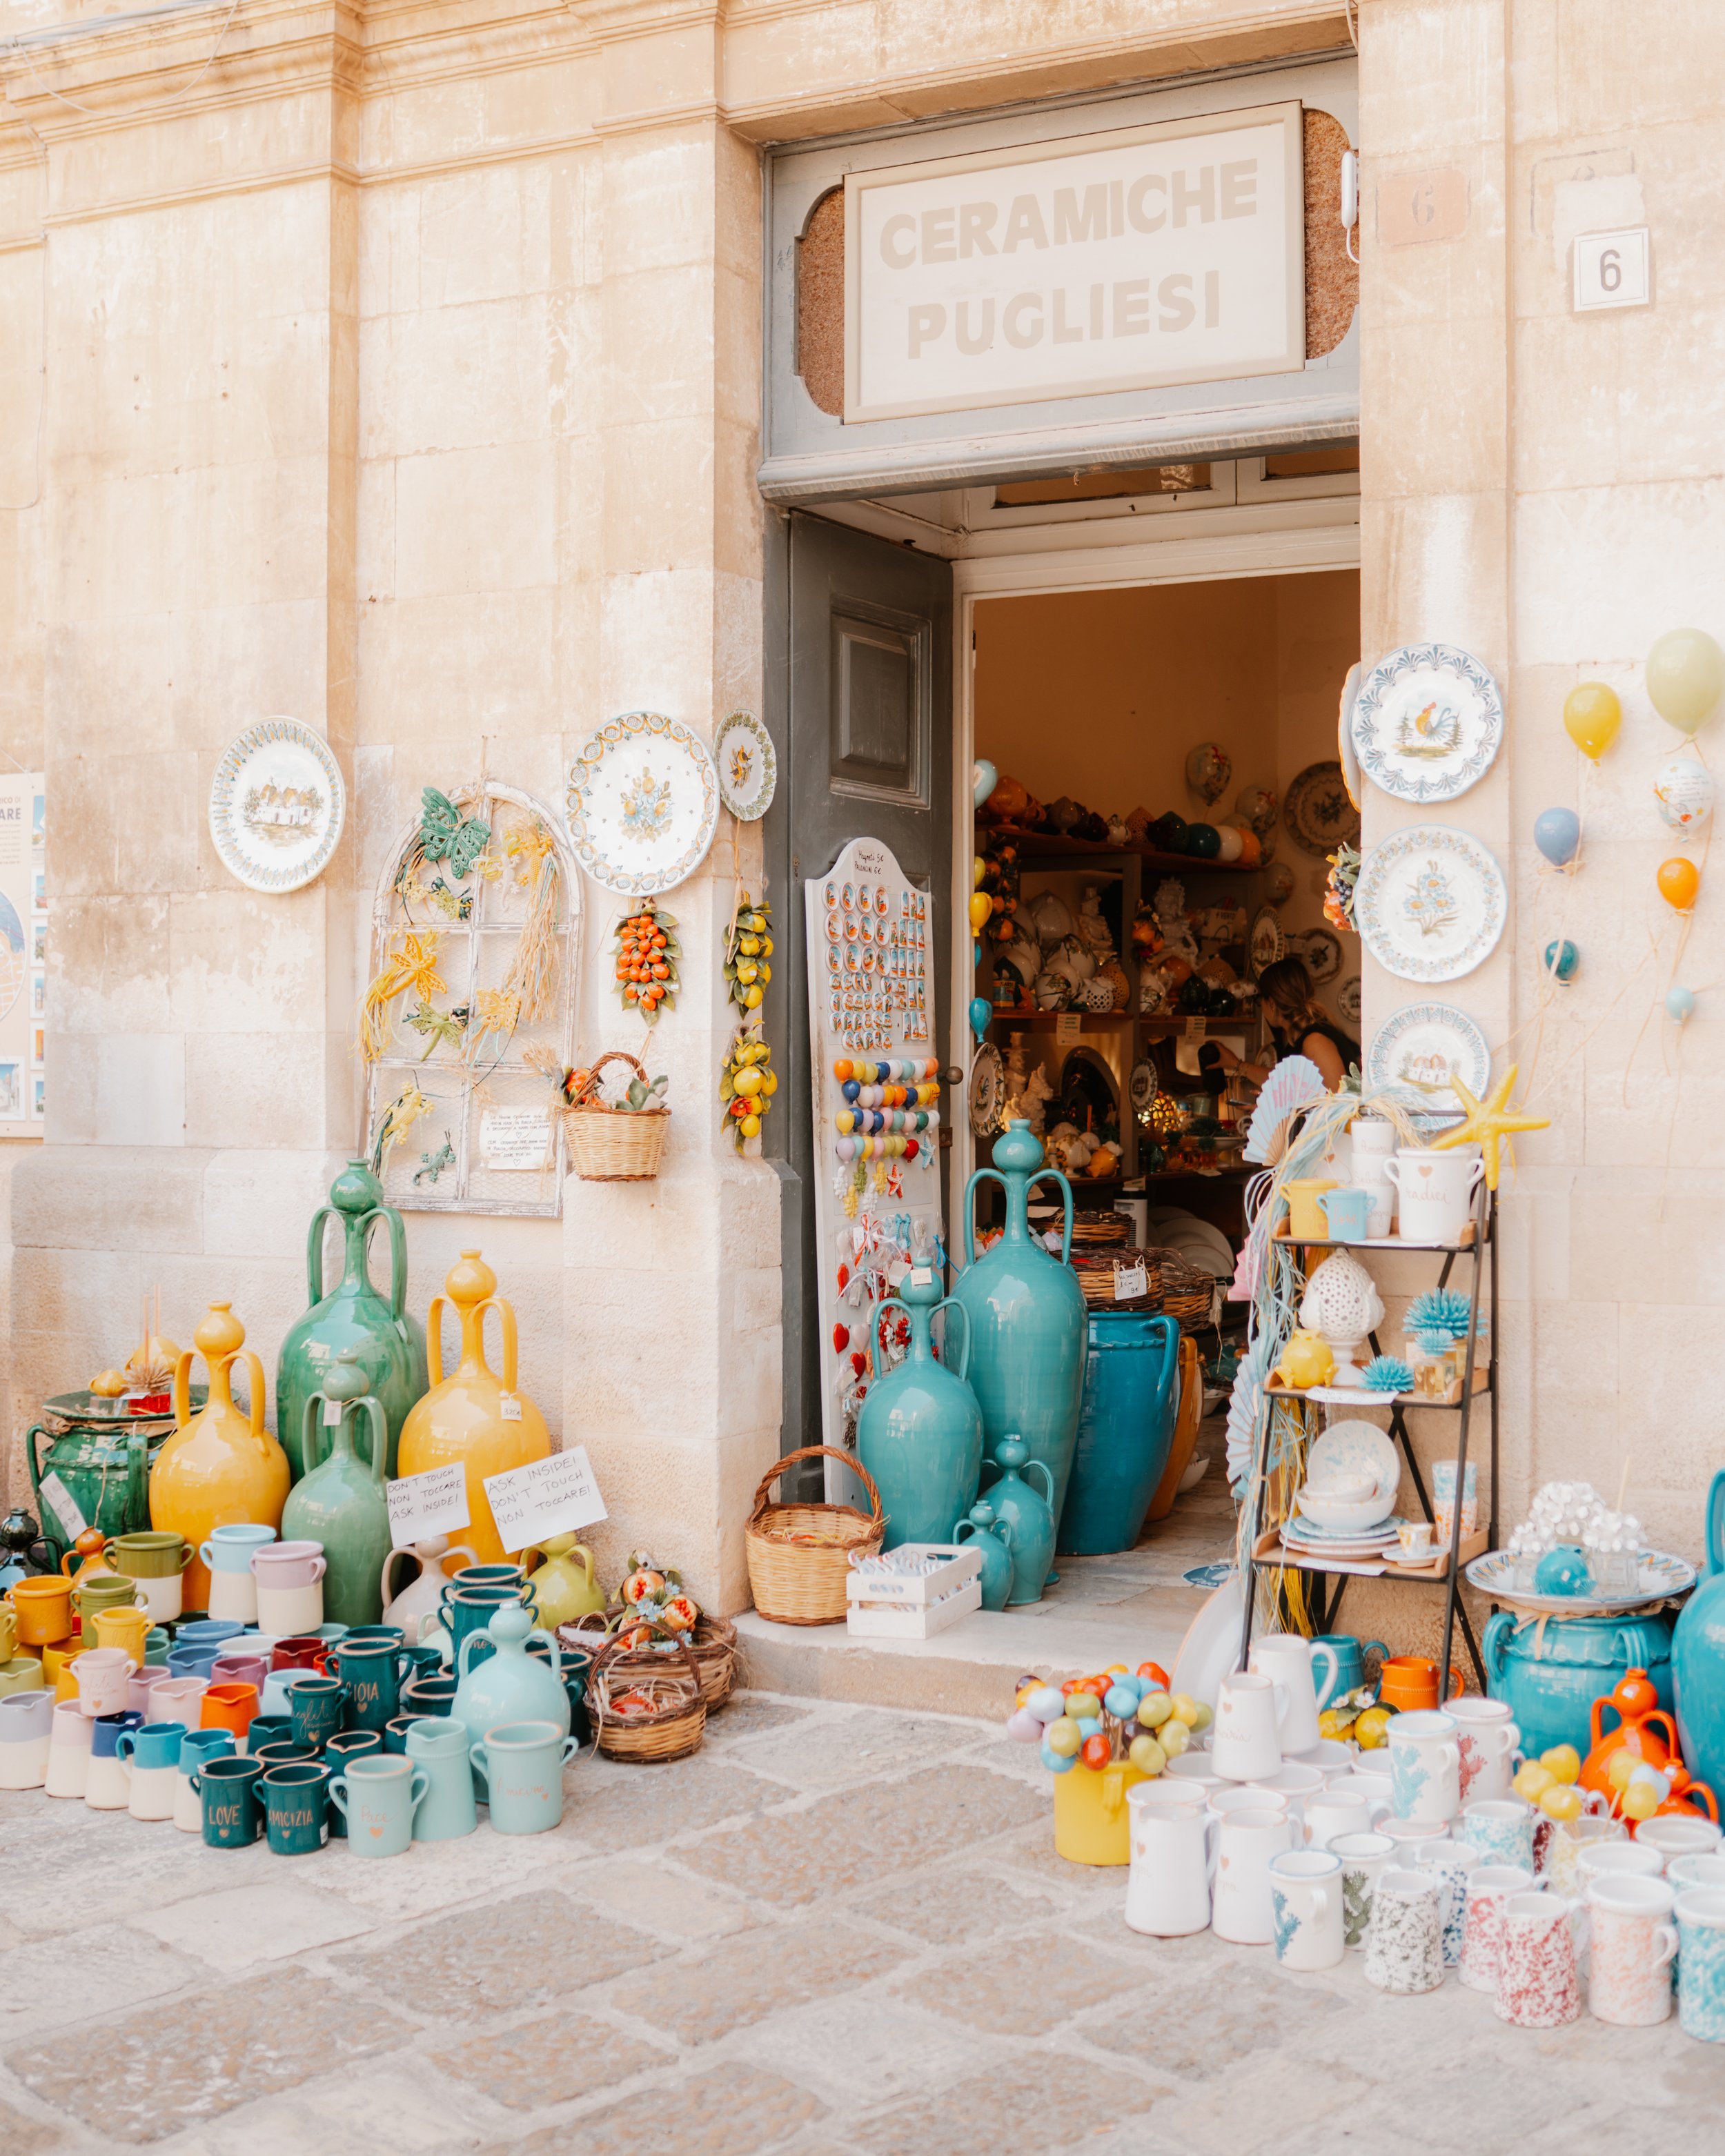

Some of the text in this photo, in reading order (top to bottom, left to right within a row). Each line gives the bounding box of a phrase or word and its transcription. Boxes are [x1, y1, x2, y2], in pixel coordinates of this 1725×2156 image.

[880, 159, 1258, 269] CERAMICHE
[1412, 182, 1435, 226] 6
[1599, 249, 1621, 292] 6
[907, 270, 1220, 359] PUGLIESI
[388, 1468, 454, 1494] DON'T TOUCH
[388, 1479, 462, 1507] NON TOCCARE
[489, 1456, 576, 1495] ASK INSIDE!
[491, 1469, 584, 1510] DON'T TOUCH
[390, 1494, 458, 1522] ASK INSIDE!
[497, 1484, 591, 1527] NON TOCCARE!
[208, 1806, 240, 1826] LOVE
[268, 1810, 313, 1828] AMICIZIA
[361, 1805, 399, 1823] Pace
